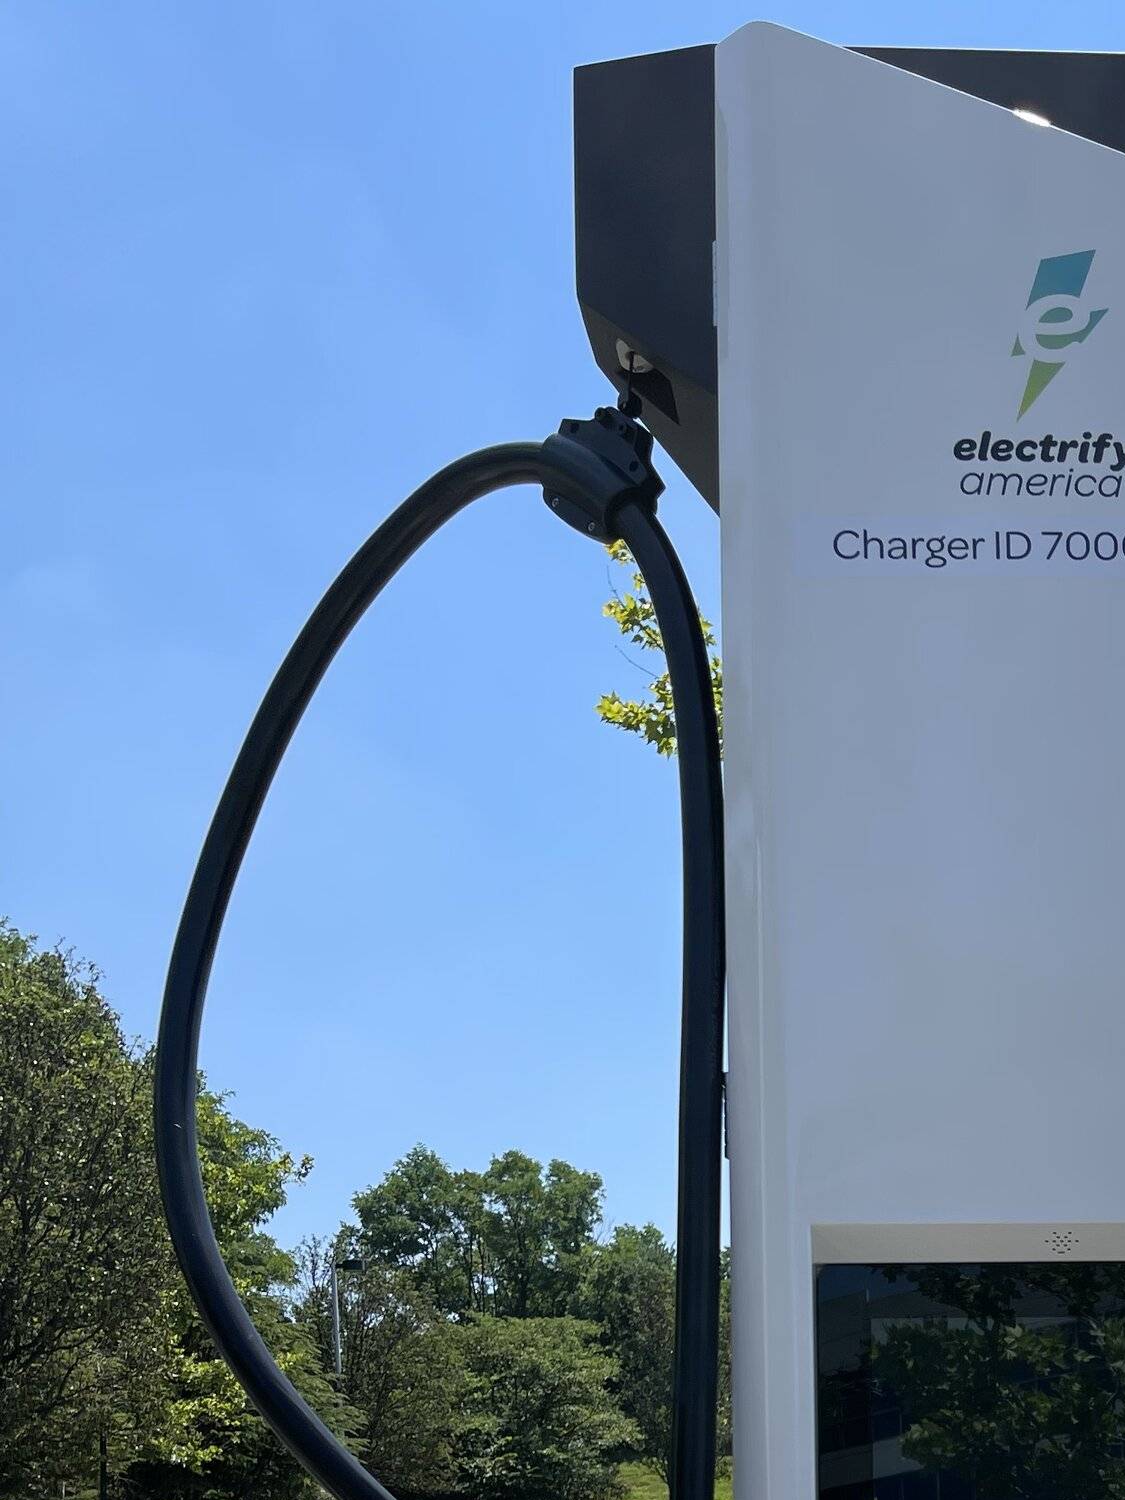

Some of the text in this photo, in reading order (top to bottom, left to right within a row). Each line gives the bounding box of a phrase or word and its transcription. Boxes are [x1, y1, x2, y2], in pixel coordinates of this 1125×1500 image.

[959, 467, 1124, 498] america
[832, 529, 986, 569] Charger
[995, 531, 1033, 560] ID
